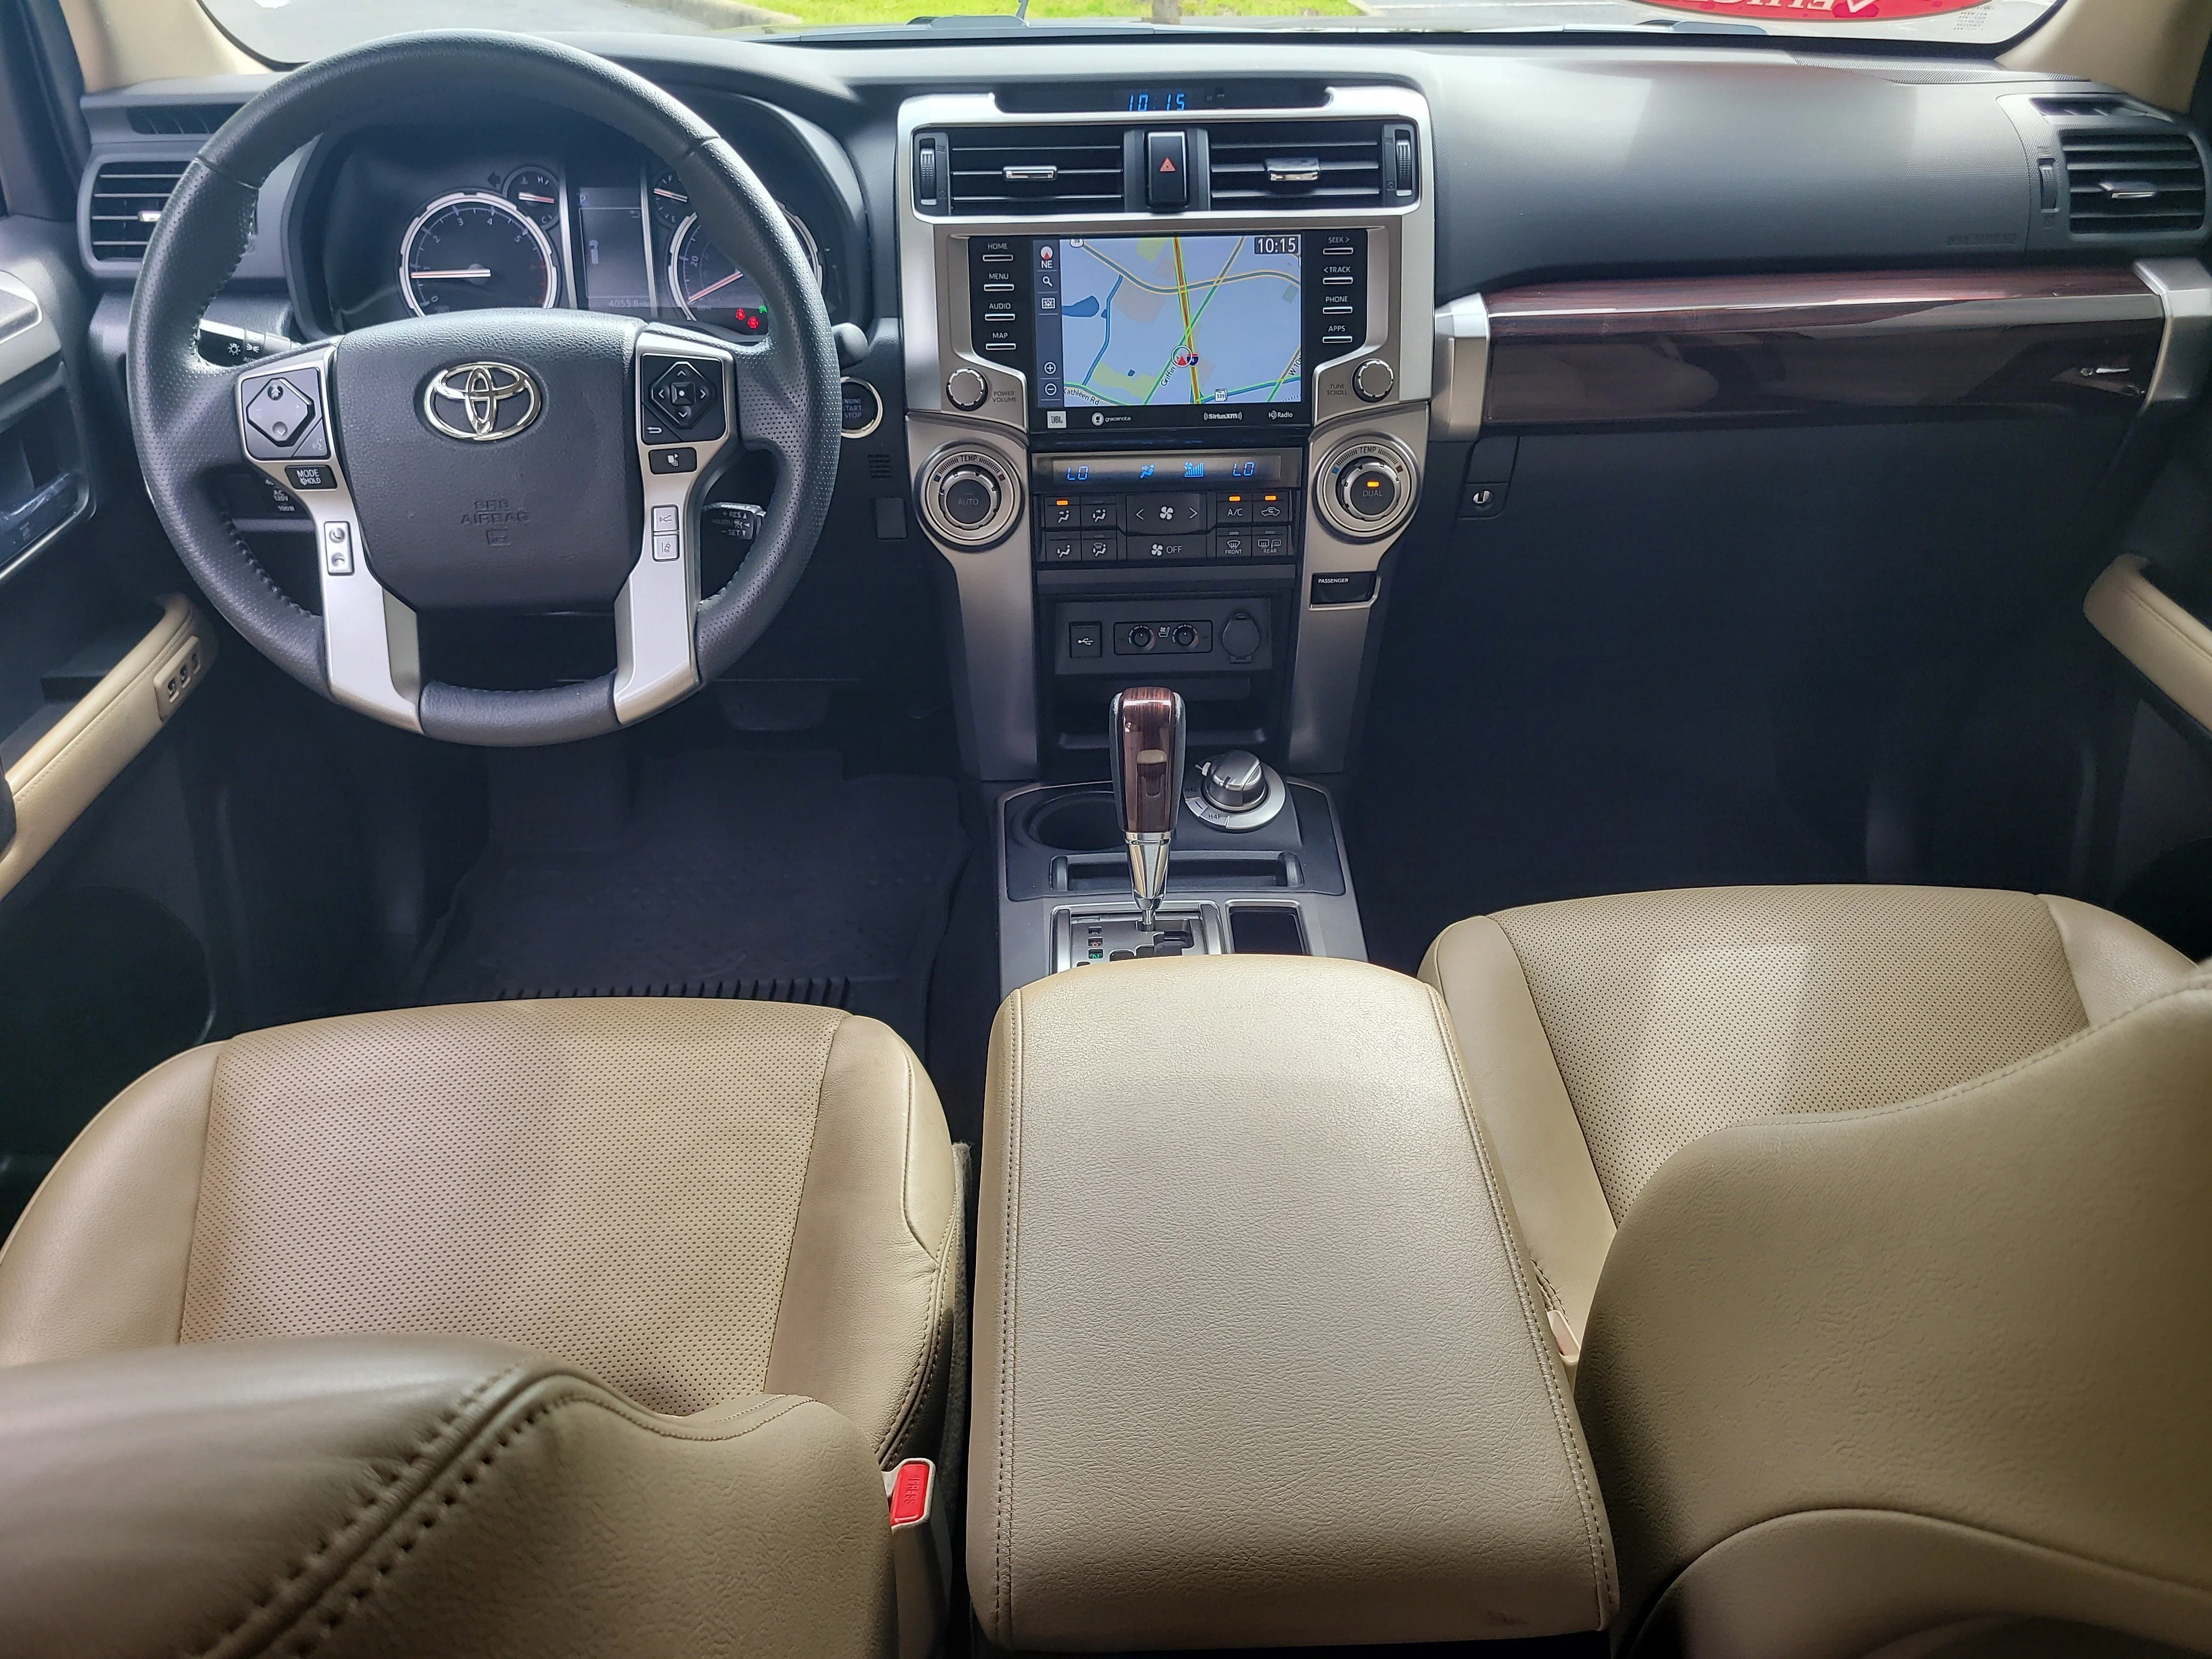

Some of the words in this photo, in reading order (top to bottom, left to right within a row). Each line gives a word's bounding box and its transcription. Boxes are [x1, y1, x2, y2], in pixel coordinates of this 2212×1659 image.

[458, 218, 464, 226] 3
[1257, 237, 1296, 253] 10:15
[1041, 260, 1053, 269] NE
[1160, 366, 1176, 386] Griffin
[1288, 367, 1296, 376] W
[1090, 396, 1100, 405] Rd
[1051, 415, 1063, 424] JBL
[297, 469, 320, 477] MODE
[1066, 466, 1090, 481] LO
[1232, 461, 1255, 477] LO
[1227, 508, 1243, 517] A/C
[1166, 546, 1182, 554] OFF
